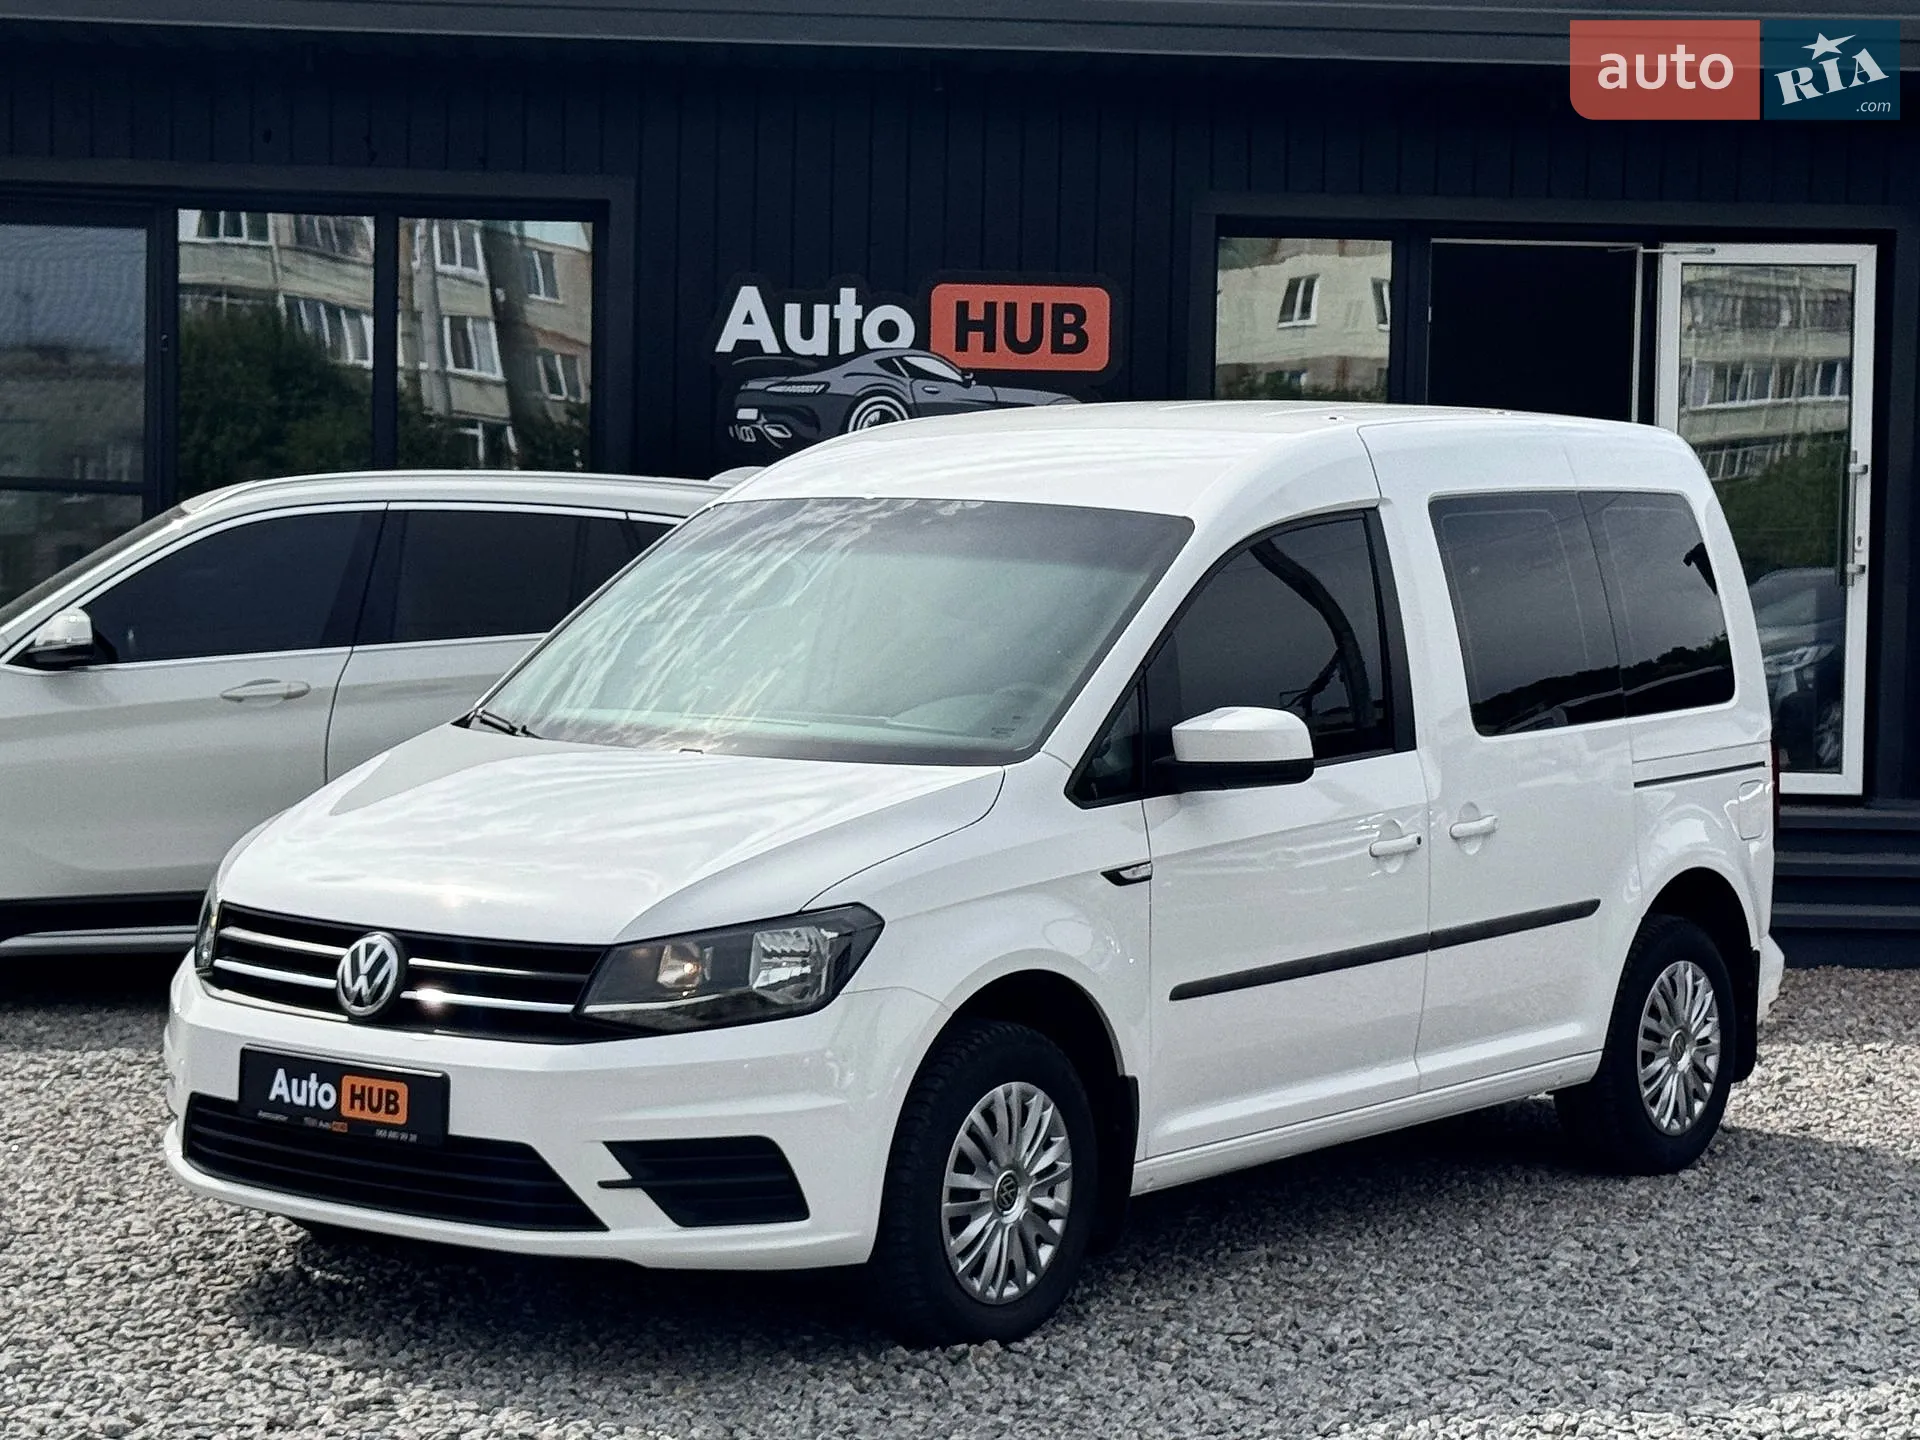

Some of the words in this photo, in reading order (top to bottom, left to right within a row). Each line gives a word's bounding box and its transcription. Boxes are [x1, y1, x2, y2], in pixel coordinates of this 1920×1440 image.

[714, 285, 916, 356] Auto
[954, 300, 1090, 356] HUB
[268, 1067, 338, 1110] Auto
[349, 1083, 401, 1116] HUB
